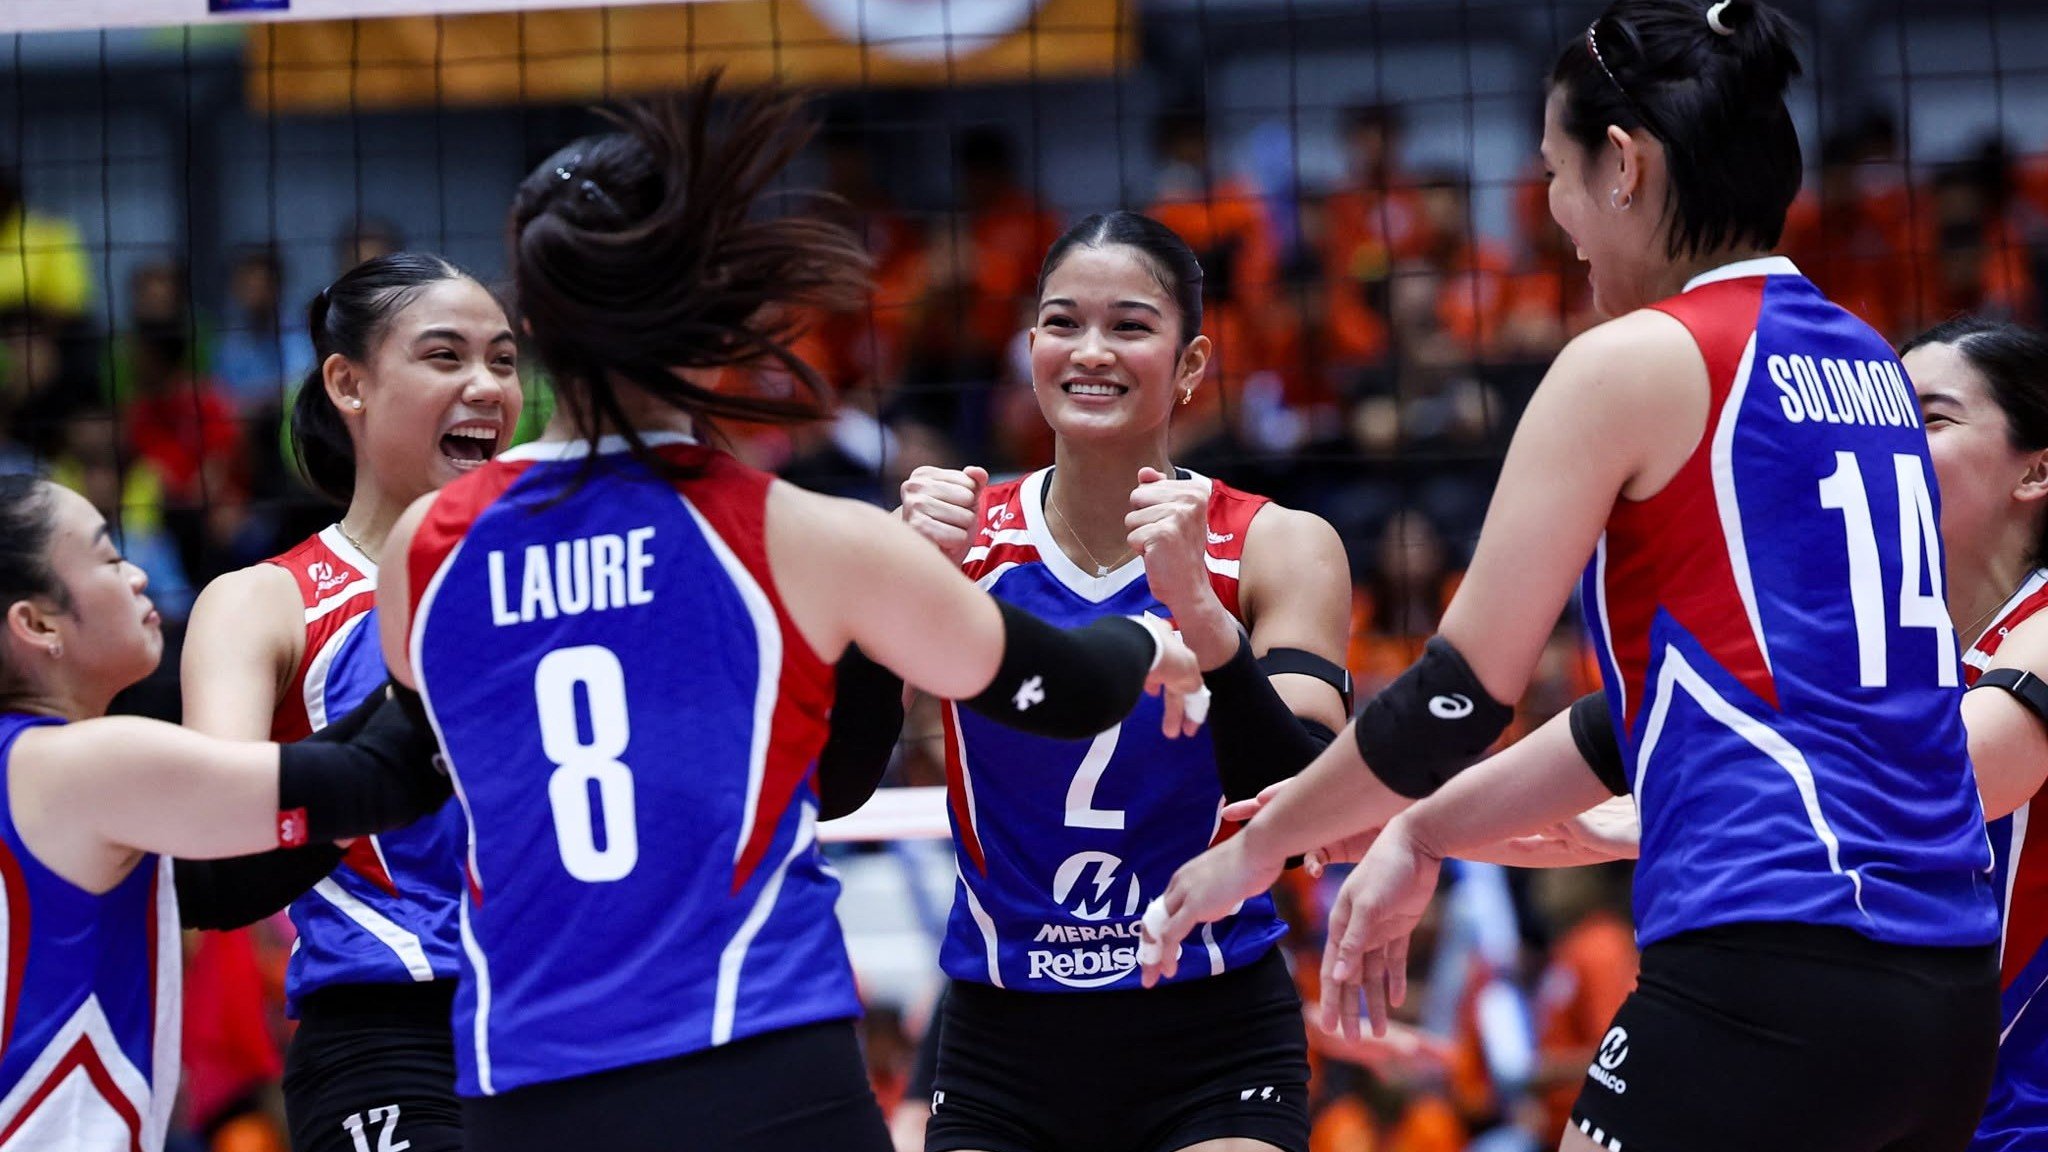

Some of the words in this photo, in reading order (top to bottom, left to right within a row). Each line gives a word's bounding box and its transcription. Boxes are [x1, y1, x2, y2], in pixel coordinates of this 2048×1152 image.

[1767, 353, 1920, 429] SOLOMON
[488, 526, 656, 627] LAURE
[1818, 450, 1959, 688] 14
[534, 644, 639, 883] 8
[1028, 944, 1182, 980] Rebis
[341, 1103, 411, 1152] 12
